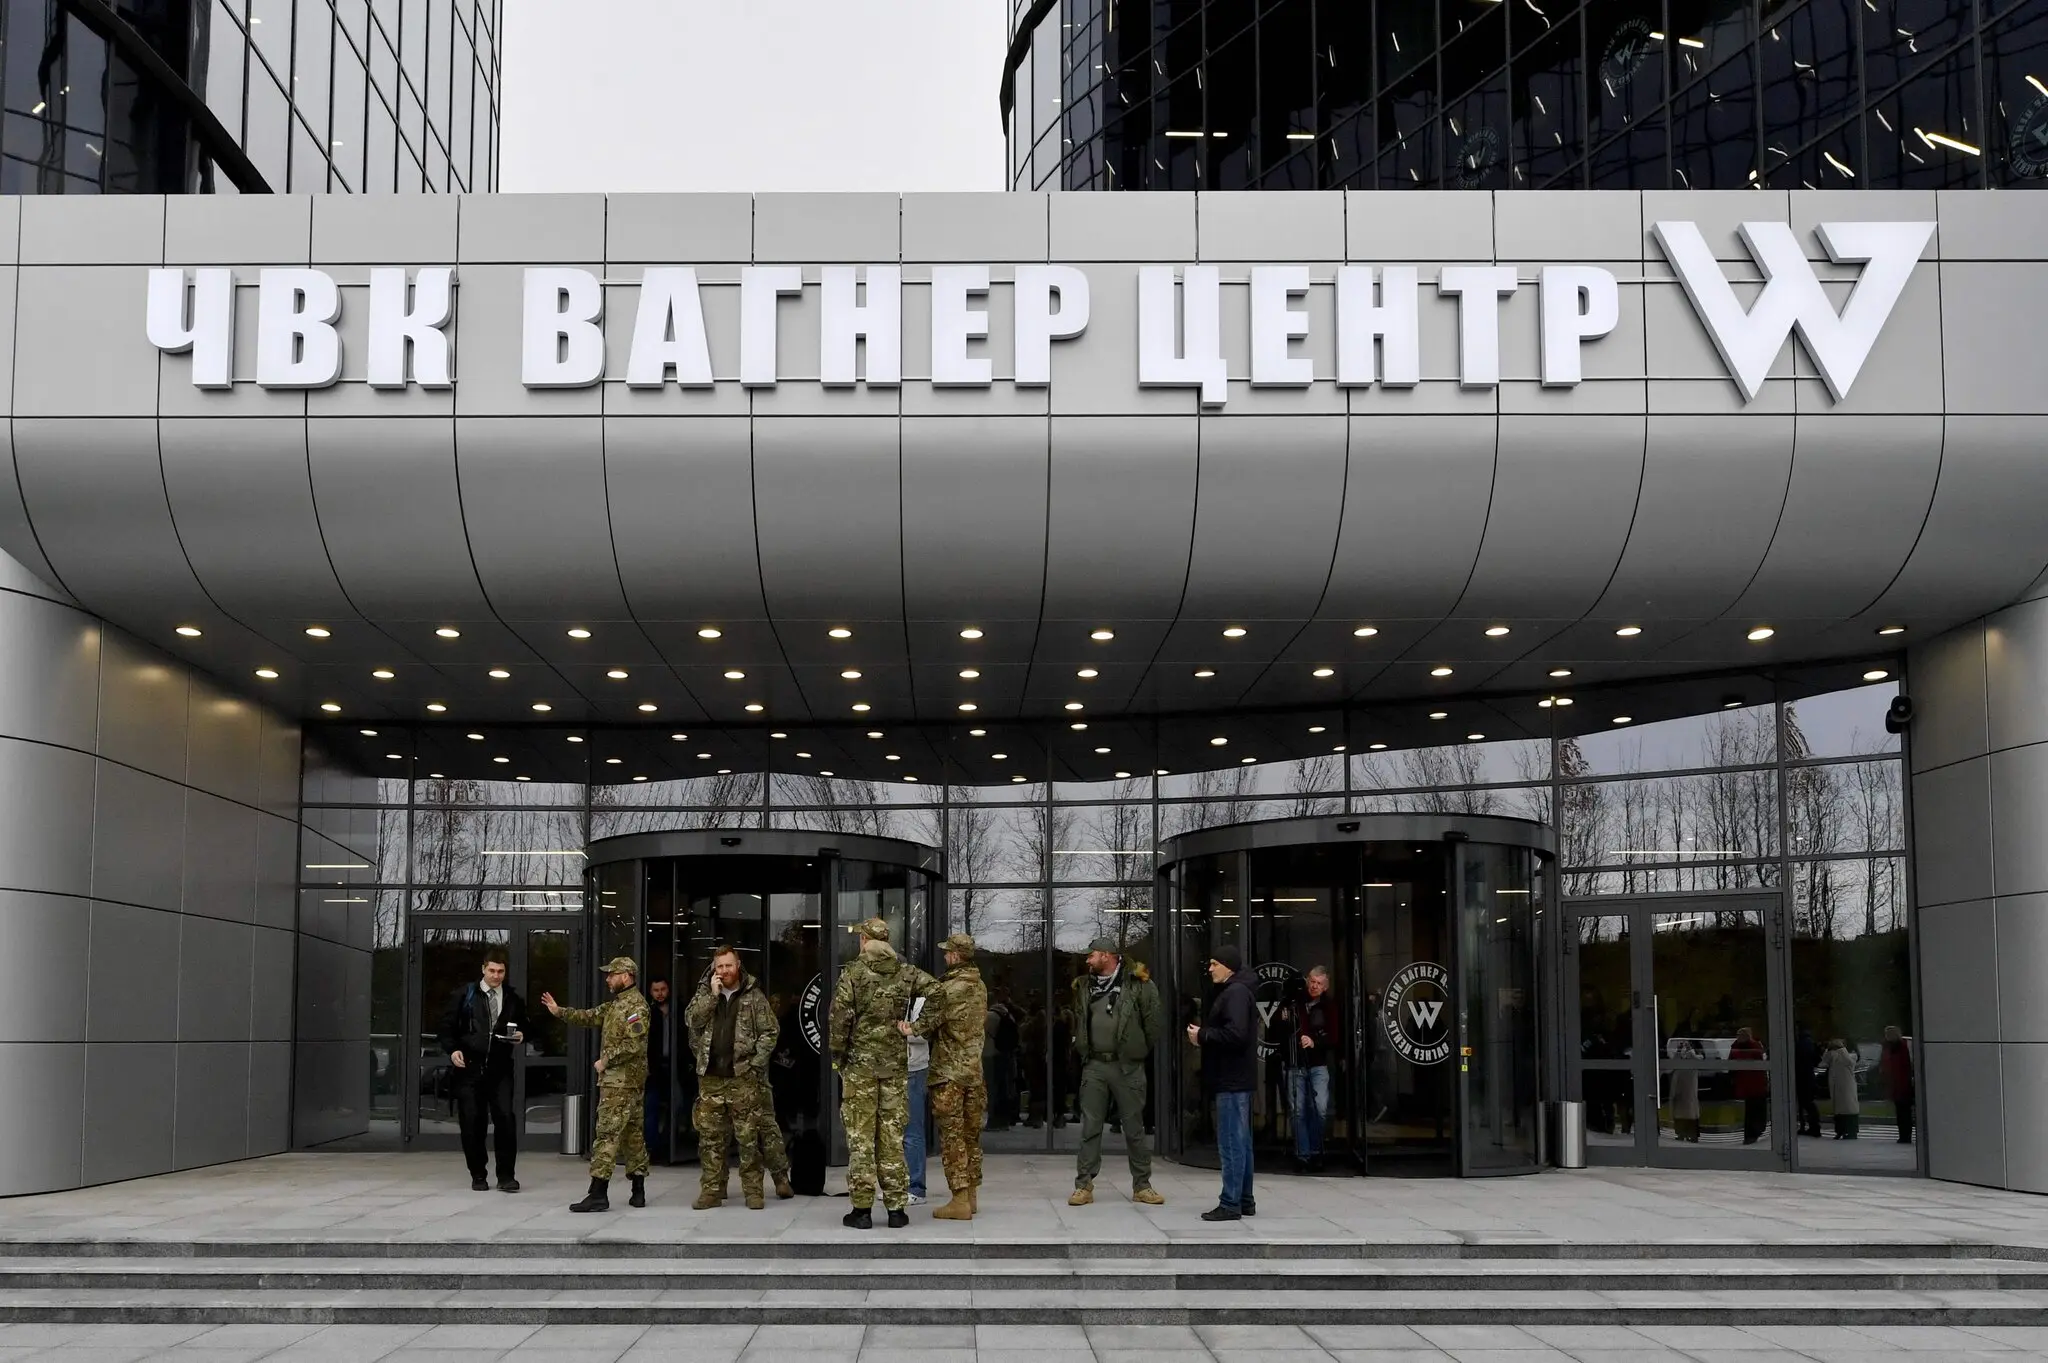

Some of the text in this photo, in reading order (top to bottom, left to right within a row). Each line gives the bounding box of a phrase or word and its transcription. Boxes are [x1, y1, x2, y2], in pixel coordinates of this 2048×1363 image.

[1648, 220, 1938, 405] W
[146, 265, 1620, 408] ЧВК ВАГНЕР ЦЕНТР
[1400, 965, 1440, 986] ВАГНЕР
[1407, 1001, 1444, 1030] W
[1387, 1020, 1450, 1061] ВАГНЕР ЦЕНТР
